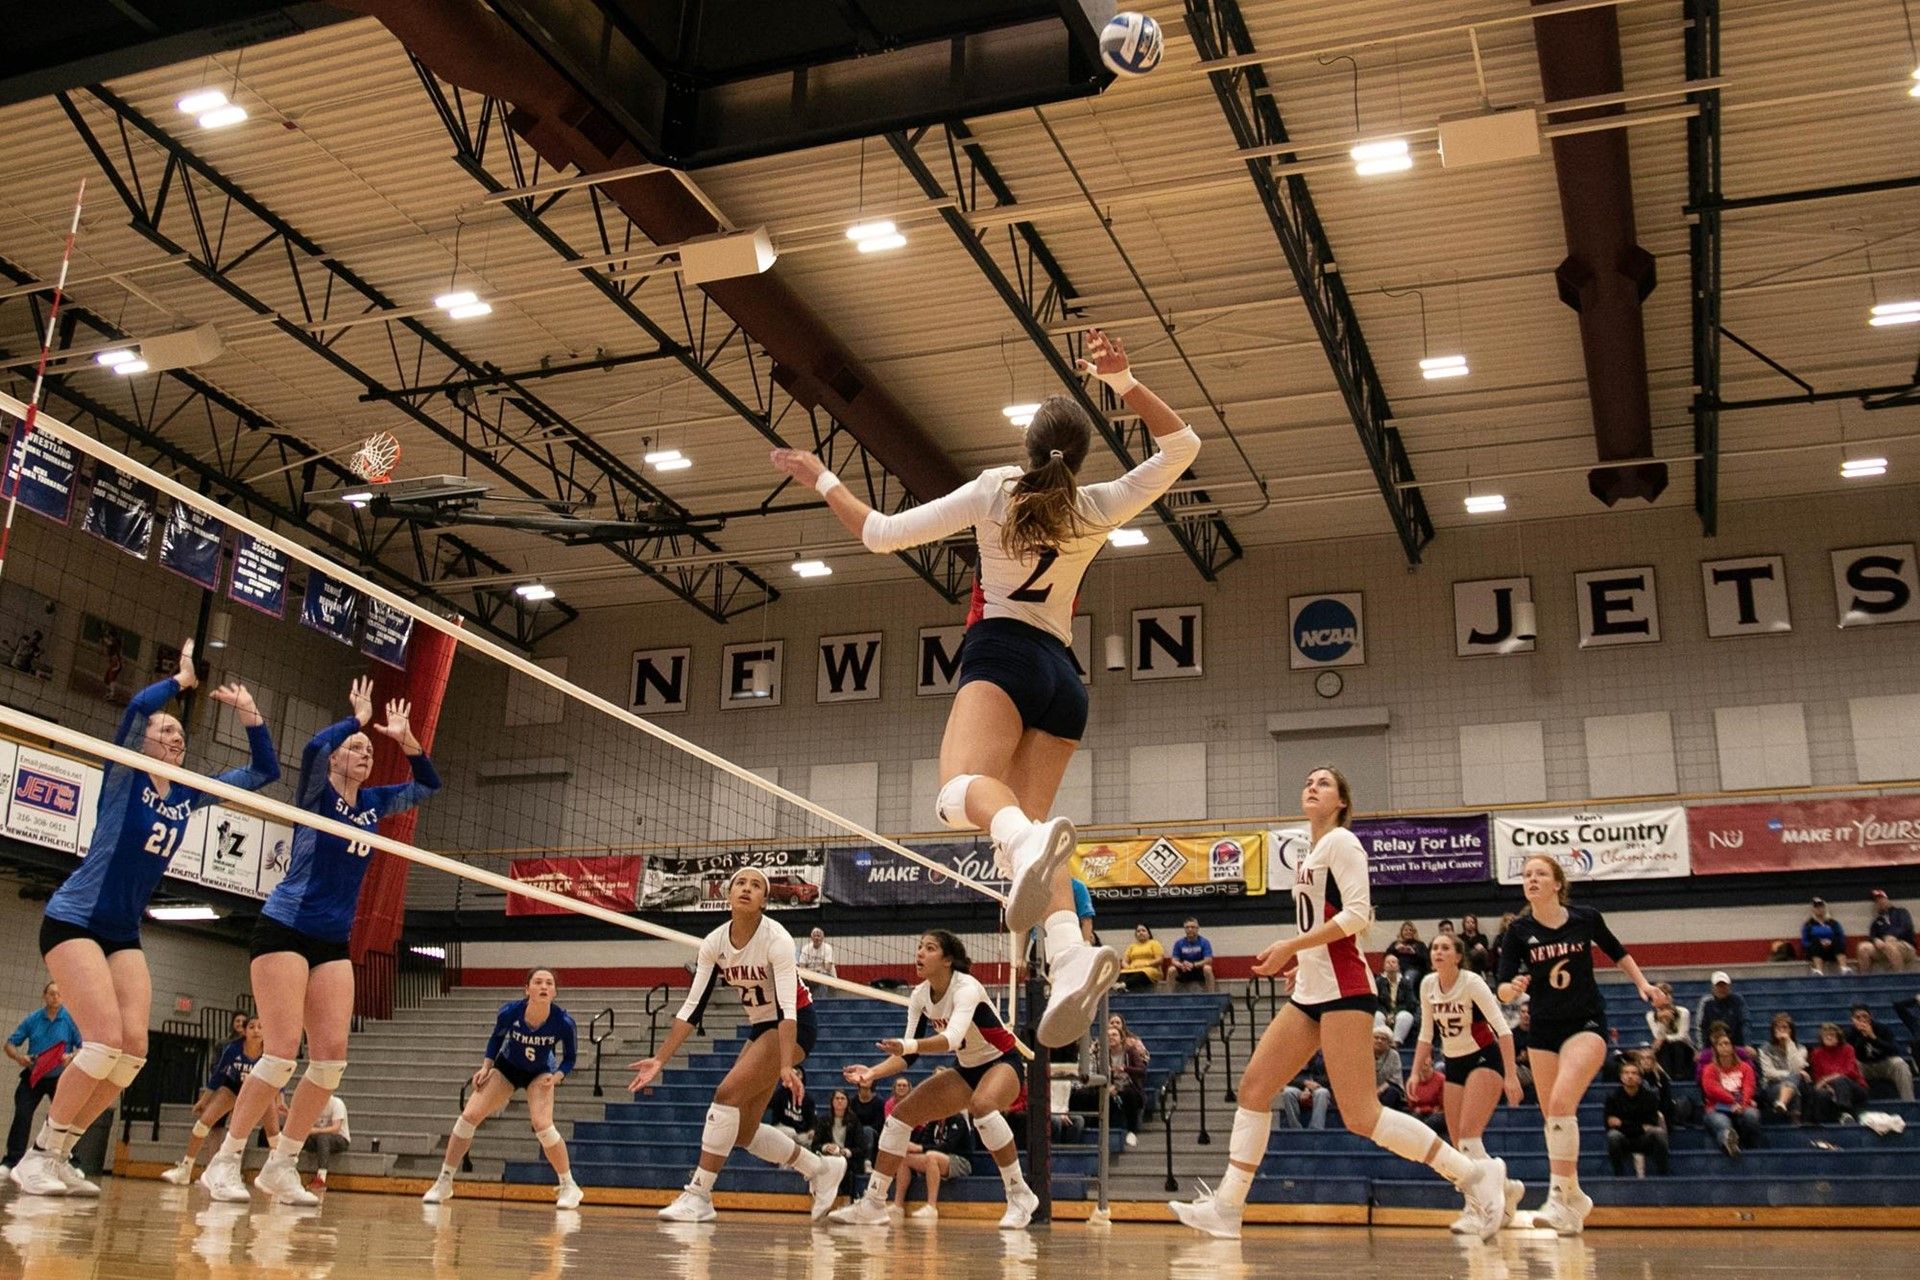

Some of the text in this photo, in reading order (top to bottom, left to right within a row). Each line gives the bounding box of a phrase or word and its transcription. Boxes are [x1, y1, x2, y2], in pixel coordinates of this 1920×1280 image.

[1007, 545, 1060, 603] 2
[1467, 555, 1911, 645] JETS
[1301, 627, 1357, 648] NCAA
[6, 826, 39, 841] NEWMAN
[38, 835, 75, 850] ATHLETICS
[143, 821, 178, 858] 21
[1416, 826, 1448, 836] Society
[1511, 822, 1669, 847] Cross Country
[1781, 828, 1833, 843] MAKE
[1834, 826, 1854, 841] IT
[227, 832, 246, 858] Z
[1373, 833, 1482, 854] Relay For Life
[676, 860, 688, 874] 2
[697, 852, 733, 872] FOR
[740, 850, 789, 868] $250
[1379, 862, 1407, 872] Event
[1407, 861, 1421, 871] To
[1421, 860, 1448, 874] Fight
[1448, 860, 1484, 870] Cancer
[1600, 848, 1678, 866] Champions
[170, 867, 200, 881] ATHLETICS
[868, 866, 920, 882] MAKE
[200, 876, 227, 889] NEWMAN
[227, 883, 256, 896] ATHLETICS
[1089, 884, 1240, 899] PROUD SPONSORS
[1529, 942, 1585, 964] NEWMAN
[1549, 958, 1572, 990] 6
[512, 1030, 555, 1046] ST MARY'S
[524, 1046, 536, 1062] 6
